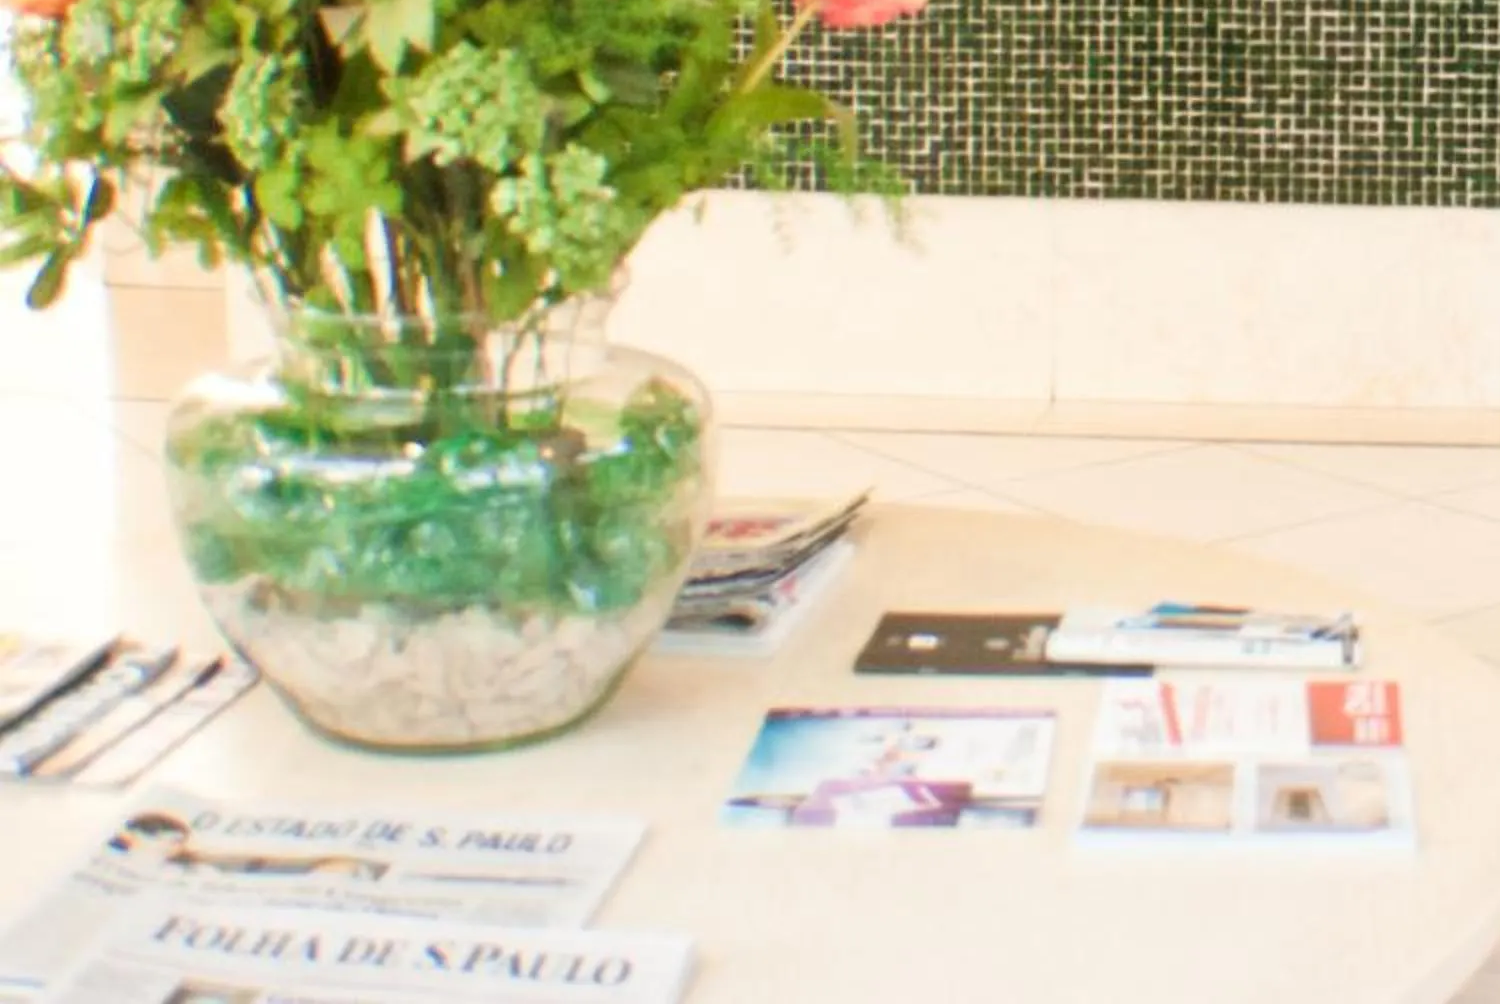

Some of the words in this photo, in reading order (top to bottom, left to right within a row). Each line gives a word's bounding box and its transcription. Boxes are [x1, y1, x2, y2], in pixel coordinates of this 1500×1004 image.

[191, 811, 221, 833] O
[224, 816, 359, 840] ESTADO
[361, 821, 412, 845] DE
[456, 830, 573, 854] PAULO
[152, 915, 322, 963] FOLHA
[337, 936, 406, 968] DE
